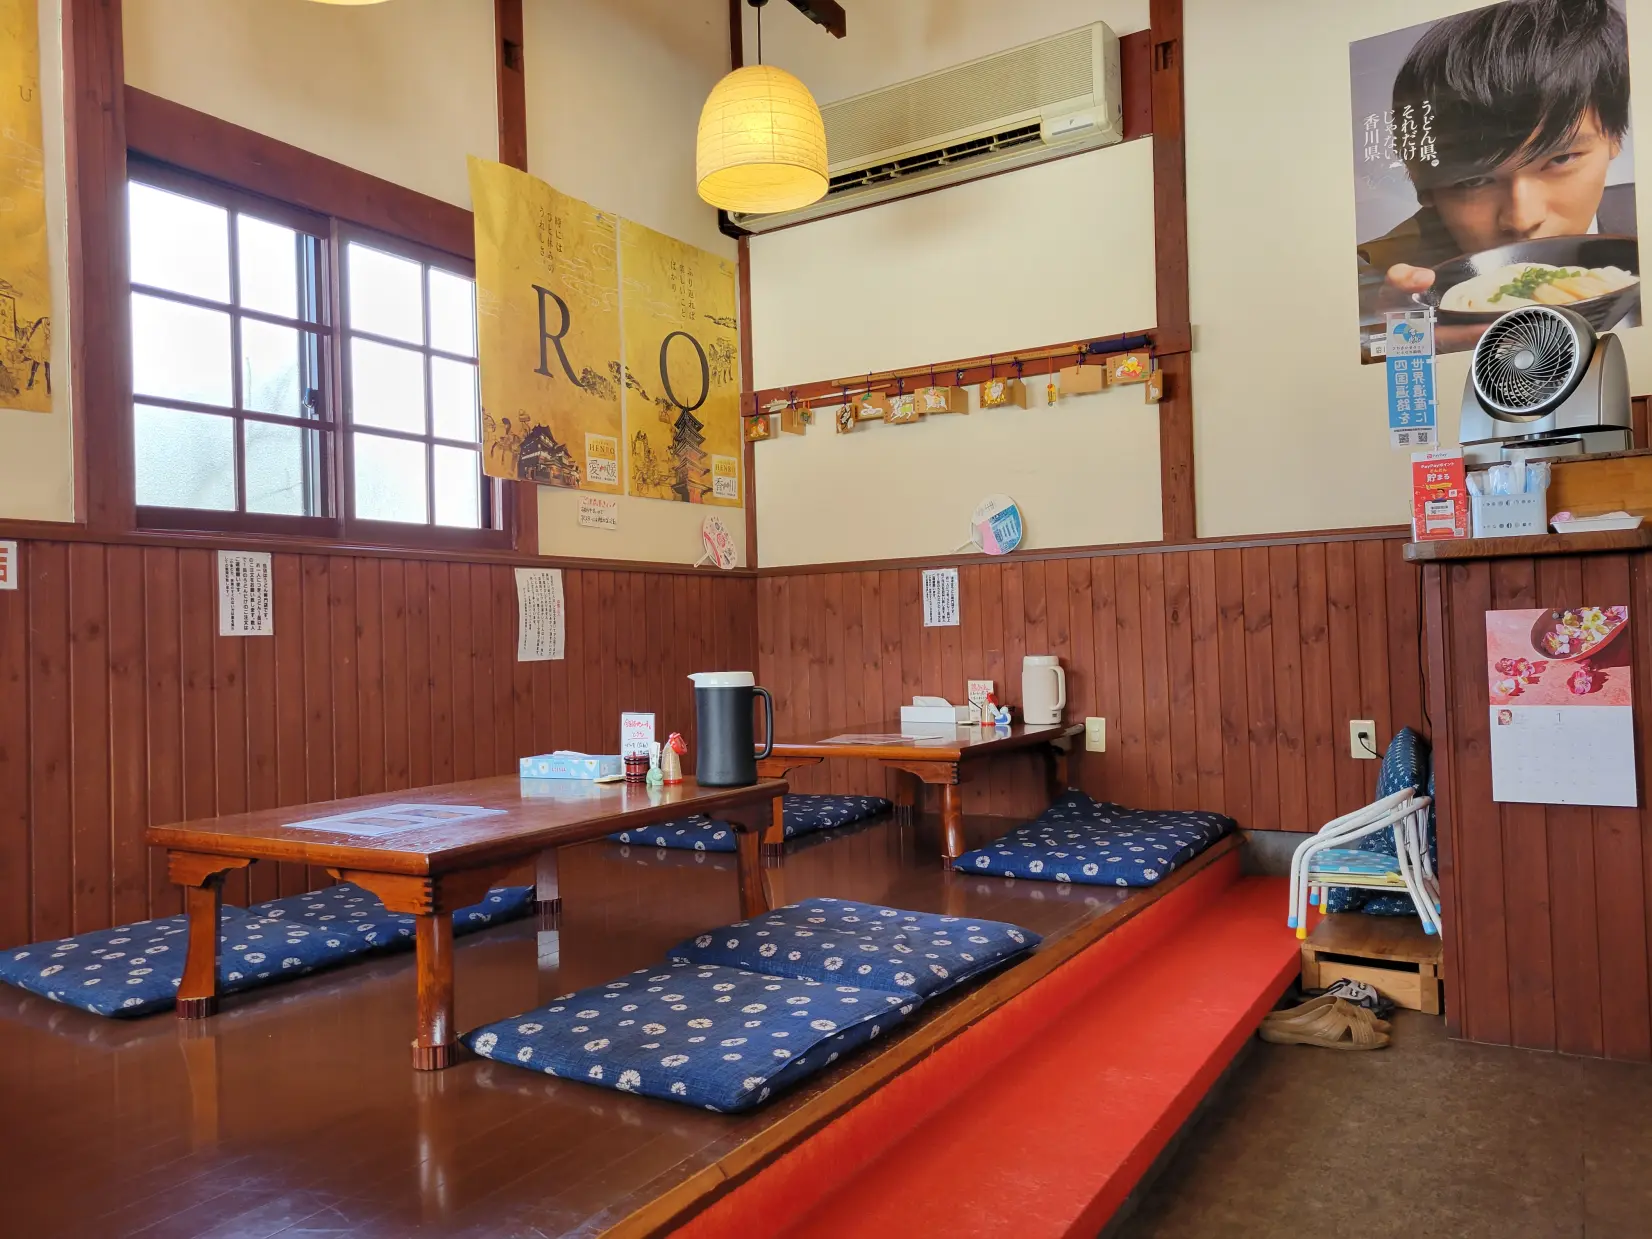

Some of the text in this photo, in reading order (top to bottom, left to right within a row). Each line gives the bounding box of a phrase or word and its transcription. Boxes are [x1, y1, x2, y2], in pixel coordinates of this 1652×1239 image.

[1363, 113, 1380, 162] 香川県
[1401, 105, 1417, 160] それだけ
[531, 284, 585, 387] R
[659, 331, 709, 411] O
[1426, 473, 1451, 482] 貯まる
